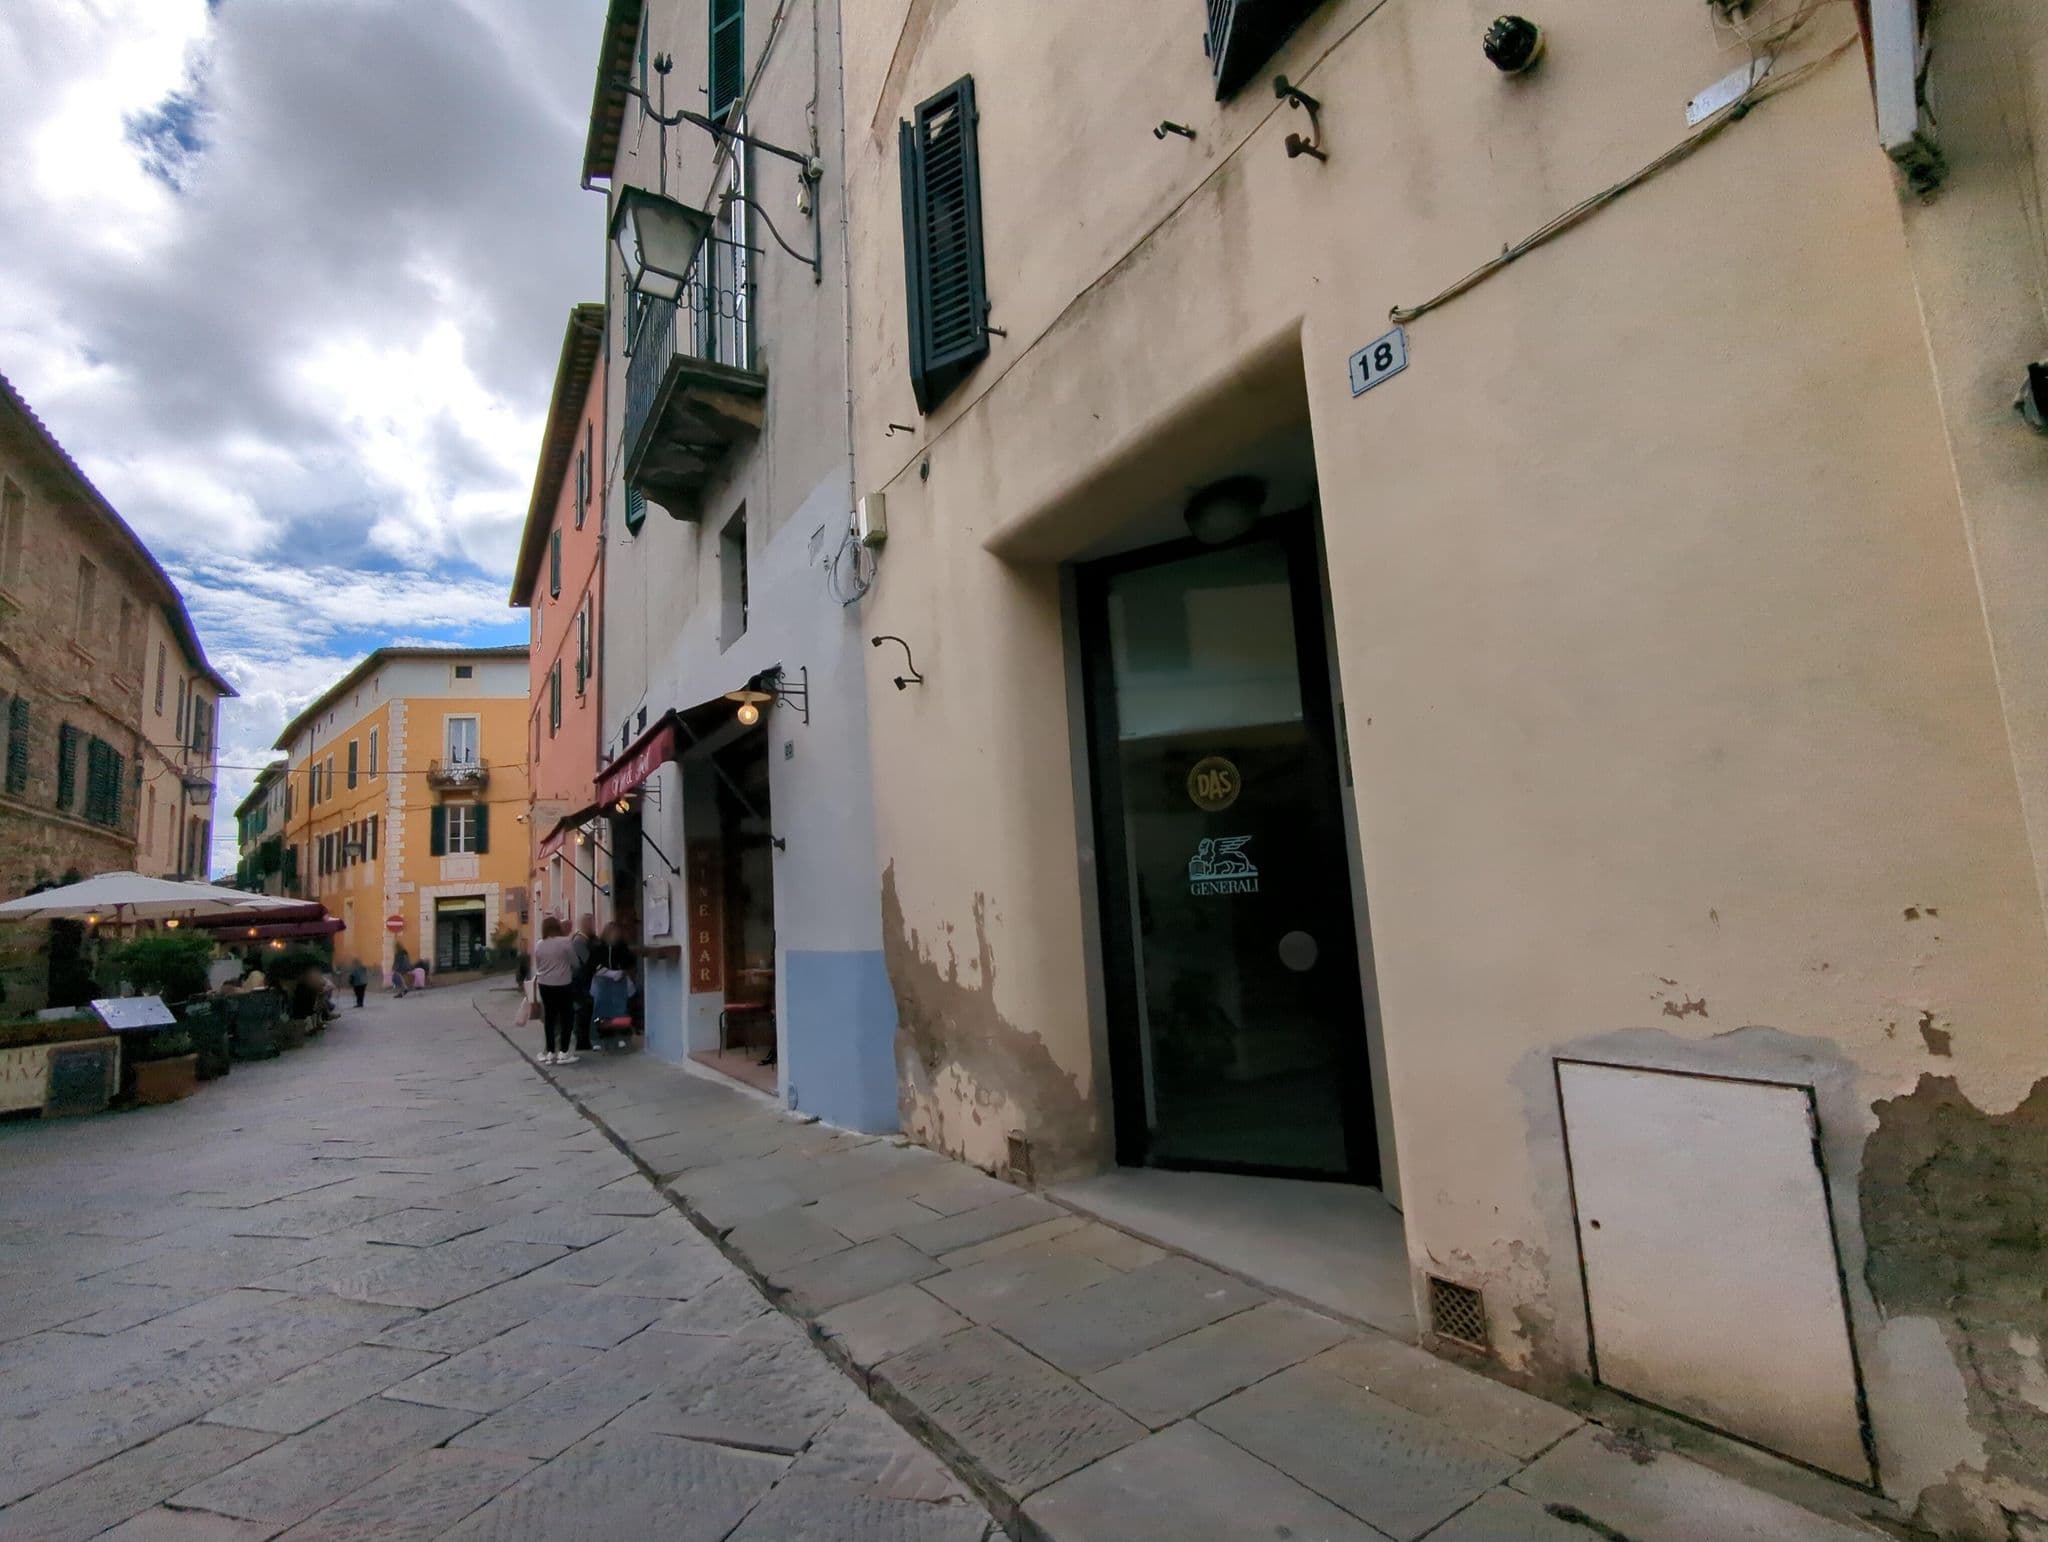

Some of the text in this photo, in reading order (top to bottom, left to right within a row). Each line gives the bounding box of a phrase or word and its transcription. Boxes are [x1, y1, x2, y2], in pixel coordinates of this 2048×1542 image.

[1358, 342, 1393, 381] 18
[1197, 769, 1232, 800] DAS
[1190, 878, 1259, 896] GENERALI
[698, 930, 712, 981] BAR
